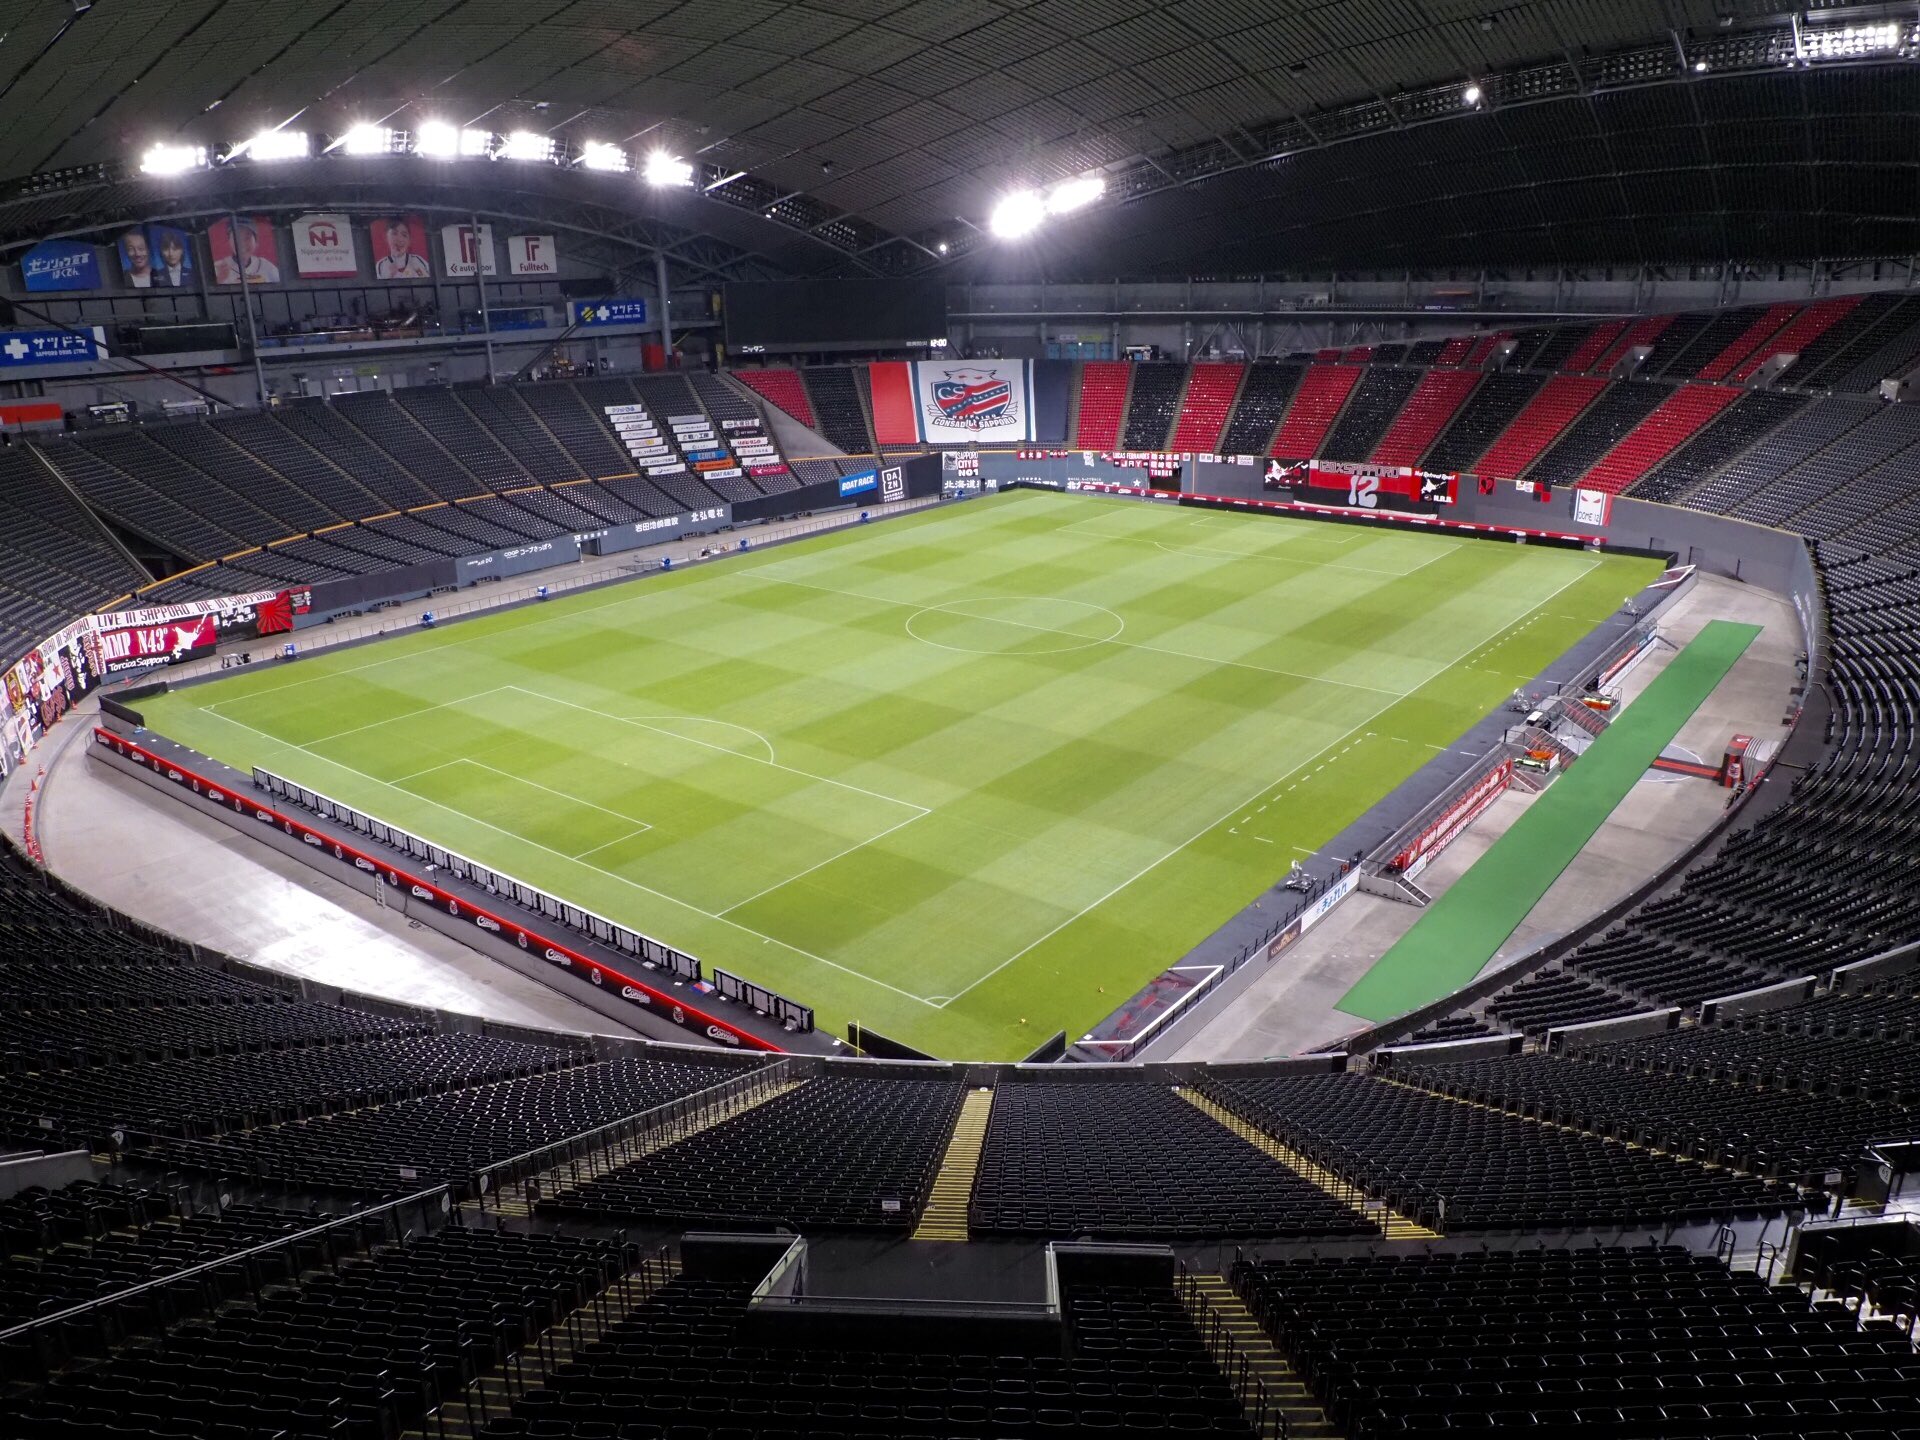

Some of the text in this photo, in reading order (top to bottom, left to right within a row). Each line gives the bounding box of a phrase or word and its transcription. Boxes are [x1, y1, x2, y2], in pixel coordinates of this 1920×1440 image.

[520, 263, 549, 271] Fulltech
[612, 304, 640, 314] サツドラ
[32, 336, 86, 350] サツドラ
[938, 386, 965, 400] CS
[980, 417, 1016, 428] SAPPORO
[957, 451, 979, 460] SAPPORO
[1127, 452, 1149, 460] FERNANDES
[957, 460, 971, 469] CITY
[886, 472, 898, 481] DA
[841, 475, 875, 491] BOAT RACE
[888, 480, 898, 490] ZN
[1348, 475, 1379, 508] 12
[691, 508, 724, 522] 北弘電社
[1578, 511, 1592, 520] DOME
[504, 543, 552, 557] COOP コープさっぽろ
[97, 615, 120, 627] LIVE
[195, 601, 215, 612] DIE
[136, 655, 170, 669] Sapporo
